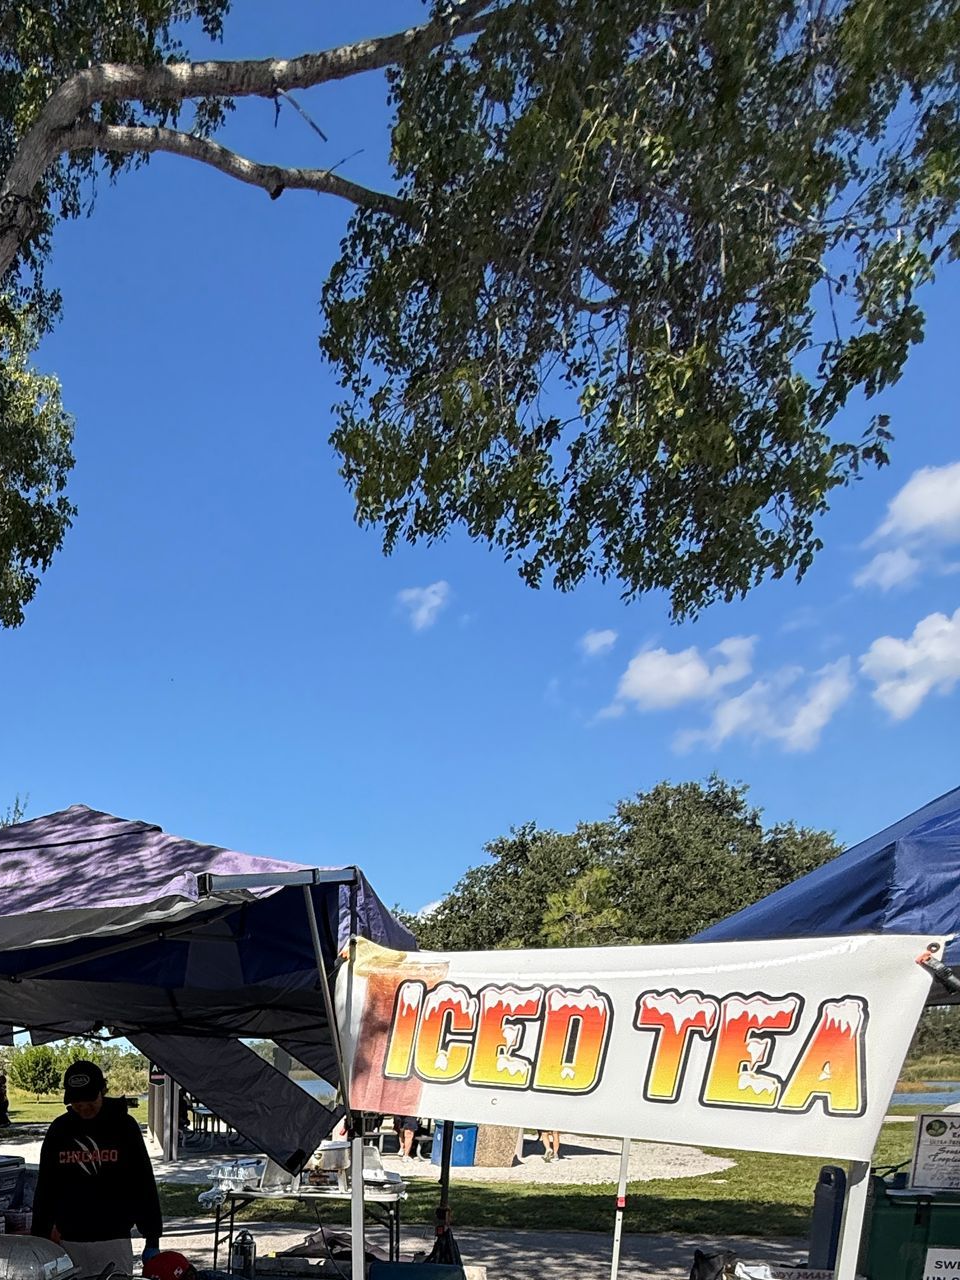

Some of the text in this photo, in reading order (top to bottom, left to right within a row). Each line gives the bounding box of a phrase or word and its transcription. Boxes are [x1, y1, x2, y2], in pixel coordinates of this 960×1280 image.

[384, 979, 869, 1118] ICED TEA
[59, 1149, 118, 1164] CHICAGO
